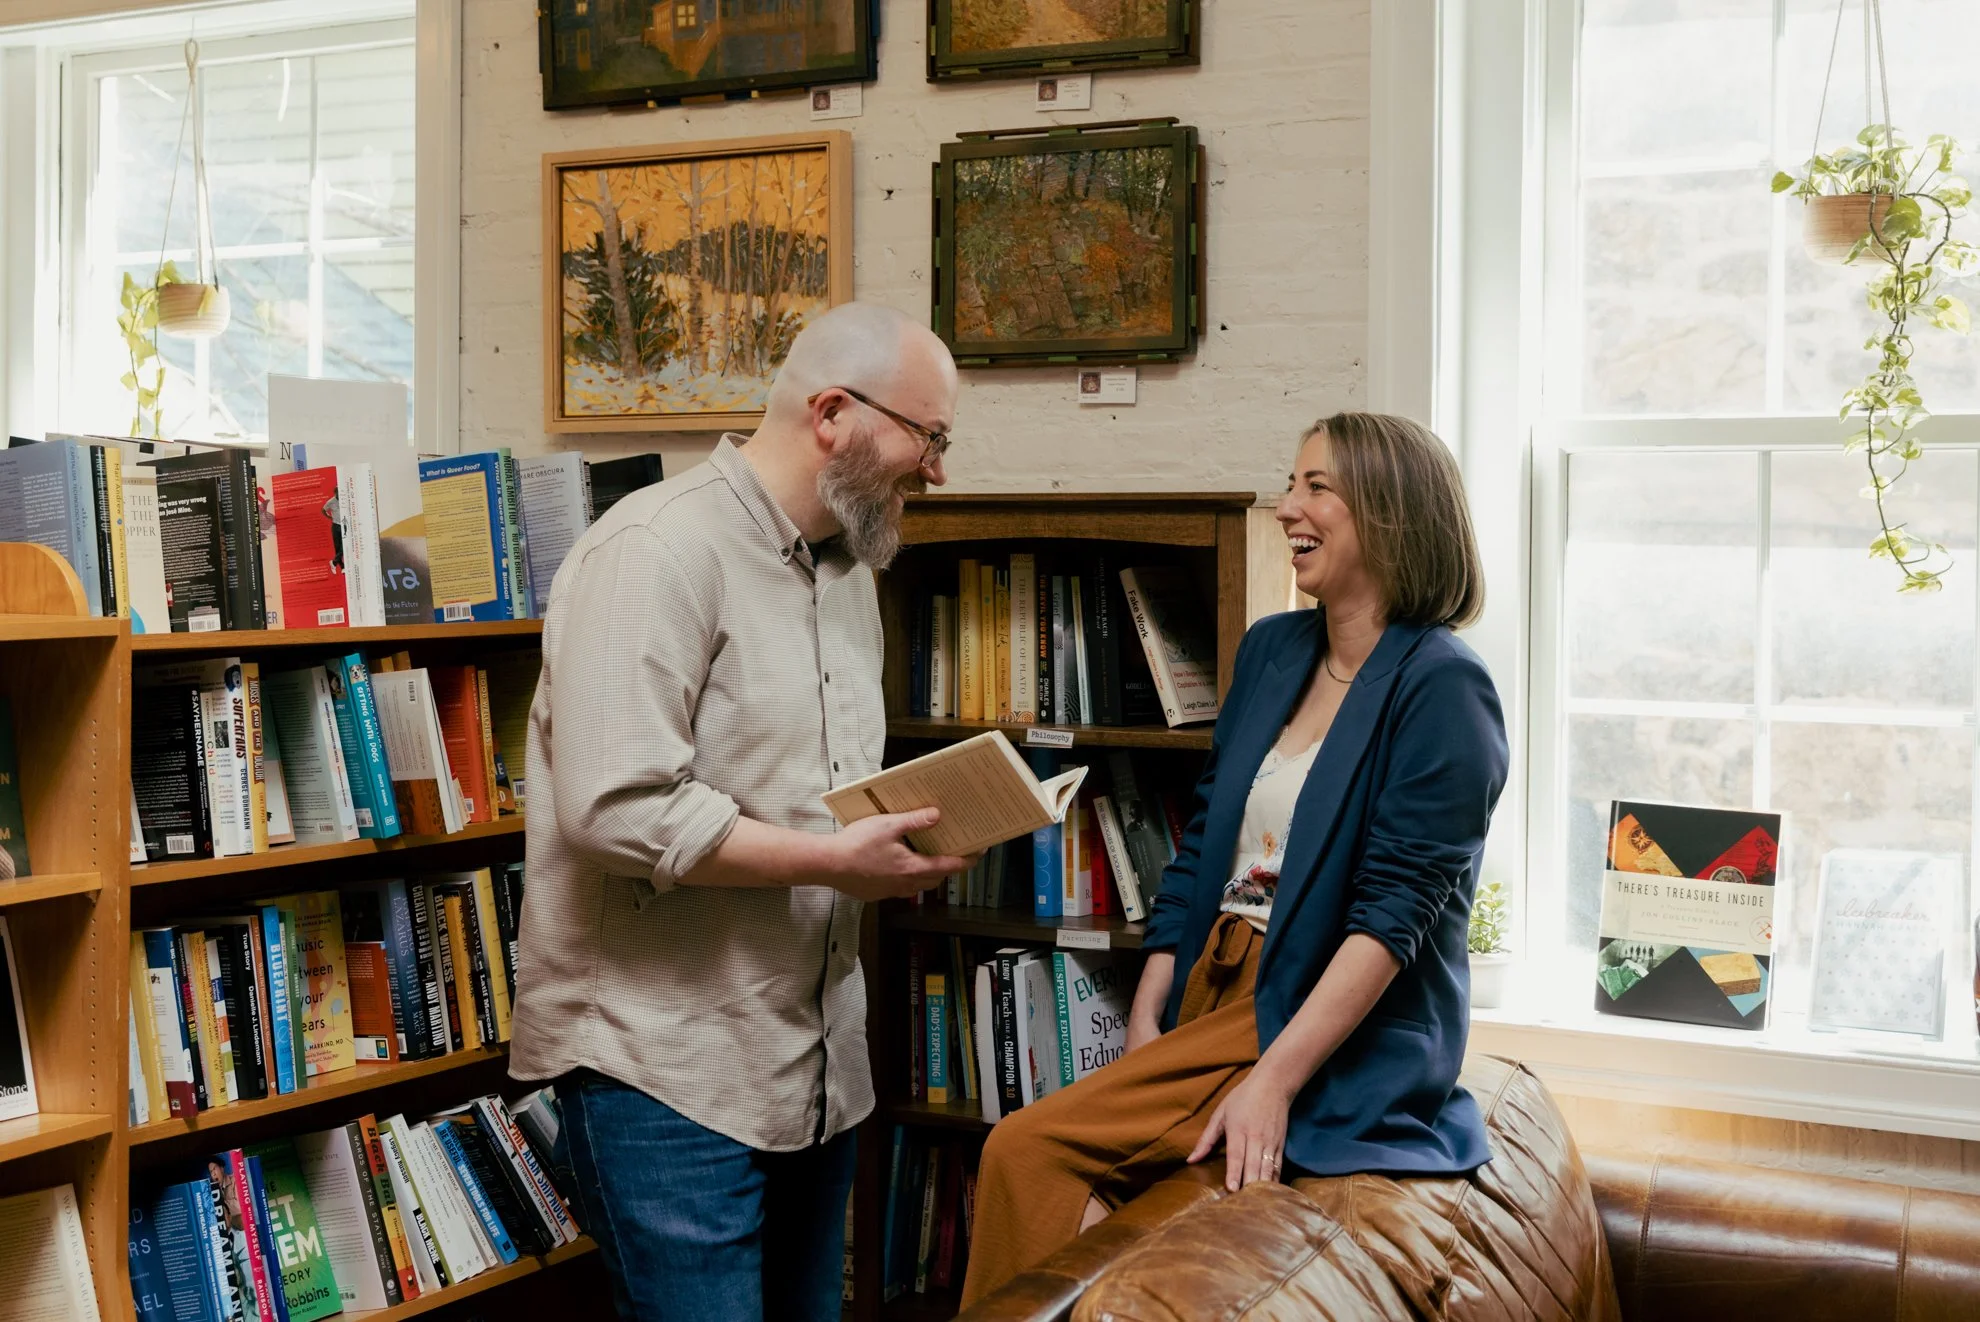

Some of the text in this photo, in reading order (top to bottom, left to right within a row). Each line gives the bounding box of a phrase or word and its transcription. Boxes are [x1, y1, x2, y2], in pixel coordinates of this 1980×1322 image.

[506, 485, 517, 525] AMBITION
[515, 562, 524, 594] BREGMAN
[1019, 578, 1027, 598] THE
[1019, 600, 1027, 646] REPUBLIC
[1128, 590, 1149, 639] Fake Work
[1019, 648, 1027, 660] OF
[250, 680, 260, 704] MOSES
[192, 690, 205, 767] #SAYHERNAME
[233, 698, 247, 759] SUPERFANS
[357, 686, 380, 763] SITTING WITH DOGS
[1030, 730, 1070, 743] Philosophy
[240, 768, 249, 793] GEORGE
[1101, 813, 1114, 845] DIALOGUES
[1111, 854, 1124, 881] SOCRATES
[412, 885, 428, 923] CHEATED
[1618, 882, 1765, 907] THERE'S TREASURE INSIDE
[394, 896, 408, 956] LAZARUS
[434, 895, 454, 983] BLACK WITNESS
[244, 950, 252, 971] Story
[299, 964, 333, 979] tween
[1002, 960, 1010, 980] LEMOV
[270, 944, 287, 1022] BLUEPRINT
[1002, 989, 1012, 1018] Teach
[248, 986, 257, 1016] Danielle
[253, 1025, 263, 1065] Lindemann
[426, 982, 445, 1046] ANDY MARTINO
[480, 974, 494, 1040] Latif Mercado
[1056, 973, 1072, 1080] SPECIAL EDUCATION
[1091, 1011, 1129, 1039] Spec
[931, 1007, 941, 1077] DAD'S EXPECTING
[1004, 1041, 1015, 1085] CHAMPION
[1006, 1087, 1016, 1098] 3.0
[486, 1104, 510, 1144] MARTIN SHAW
[509, 1123, 526, 1150] PHIL
[367, 1127, 396, 1211] Black Ball
[388, 1138, 401, 1160] Legacy
[353, 1134, 384, 1243] WARDS OF THE STATE
[439, 1128, 500, 1238] BE USEFUL SEVEN TOOLS FOR LIFE
[523, 1149, 568, 1226] ALAN SHIPNUCK
[196, 1192, 208, 1239] MEN'S HEALTH
[237, 1162, 251, 1204] PLAYING
[249, 1224, 261, 1261] MYSELF
[268, 1194, 295, 1232] ET
[275, 1226, 323, 1270] EM
[416, 1213, 440, 1264] BLACK MEME
[257, 1279, 268, 1316] RAINBOW
